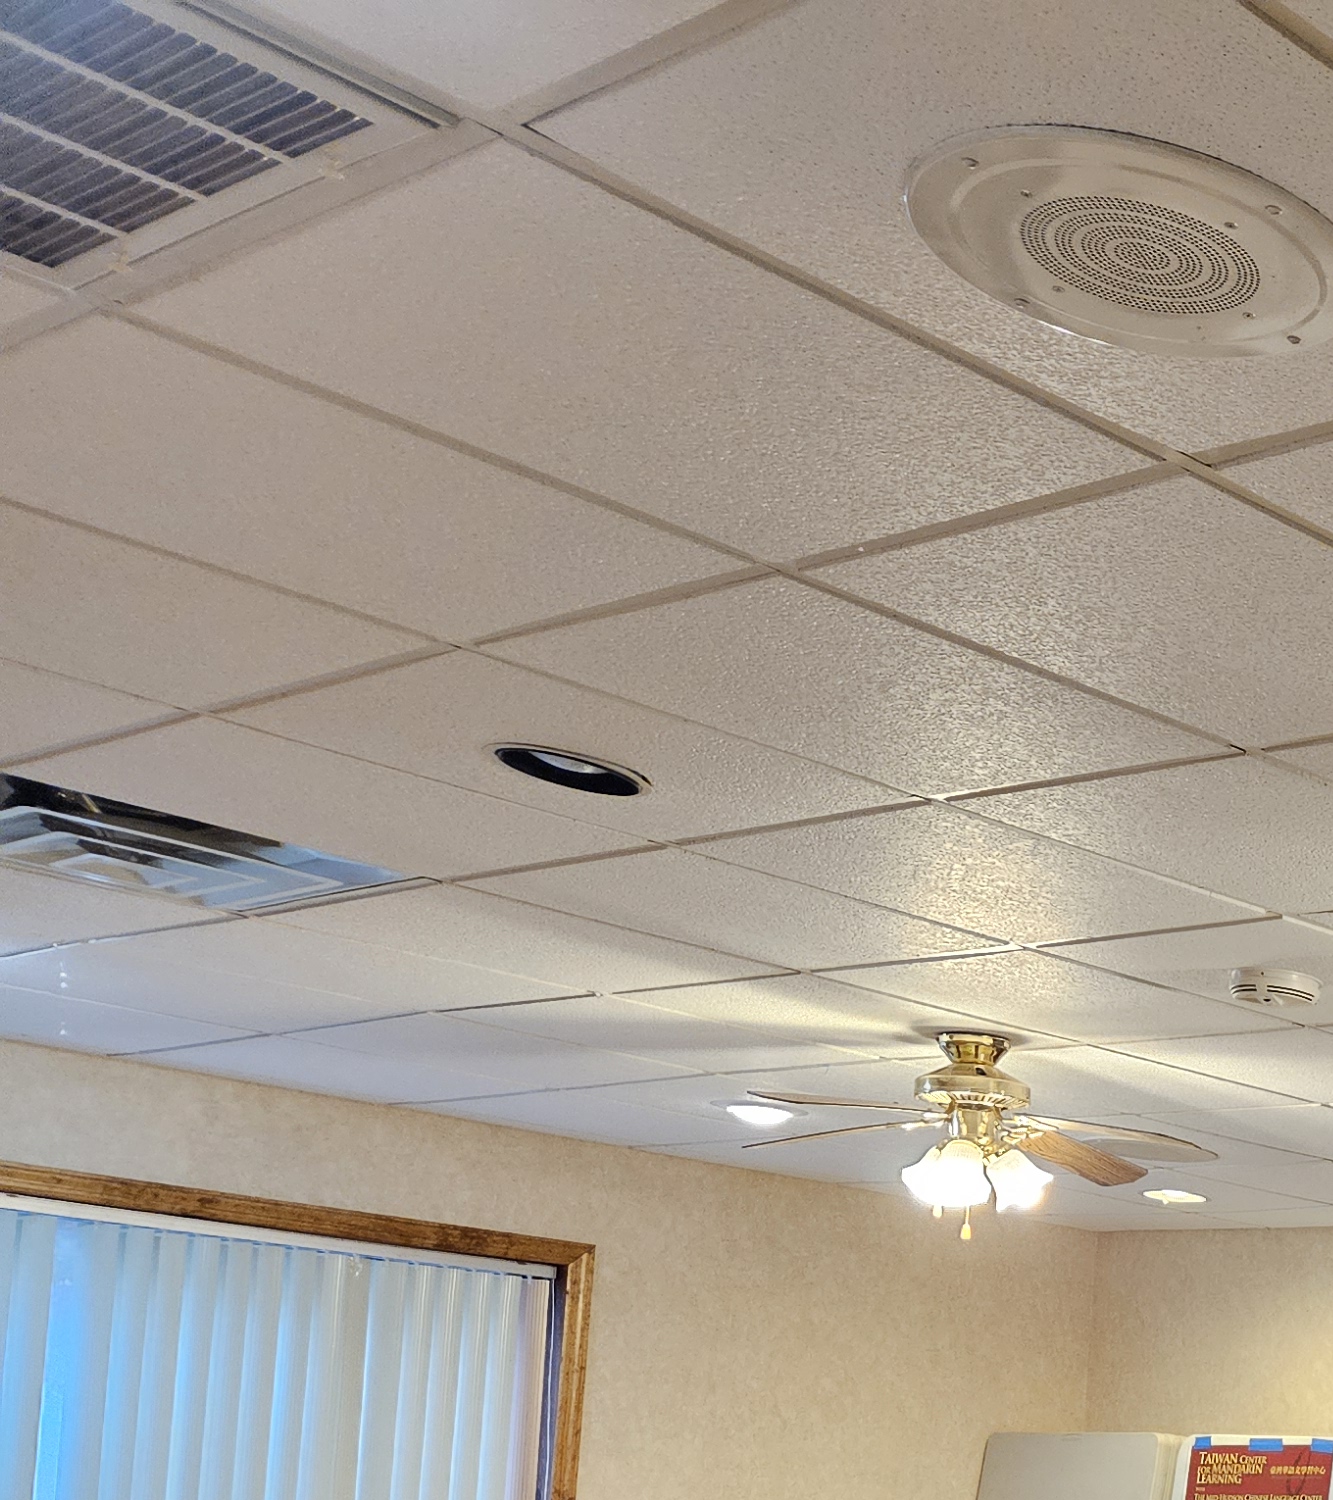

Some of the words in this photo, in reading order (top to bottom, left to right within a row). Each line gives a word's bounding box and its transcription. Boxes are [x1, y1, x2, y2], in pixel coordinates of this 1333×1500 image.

[1199, 1451, 1238, 1464] TAIWAN
[1240, 1455, 1267, 1464] CENTER
[1212, 1463, 1263, 1474] MANDARIN
[1196, 1474, 1242, 1484] LEARNING
